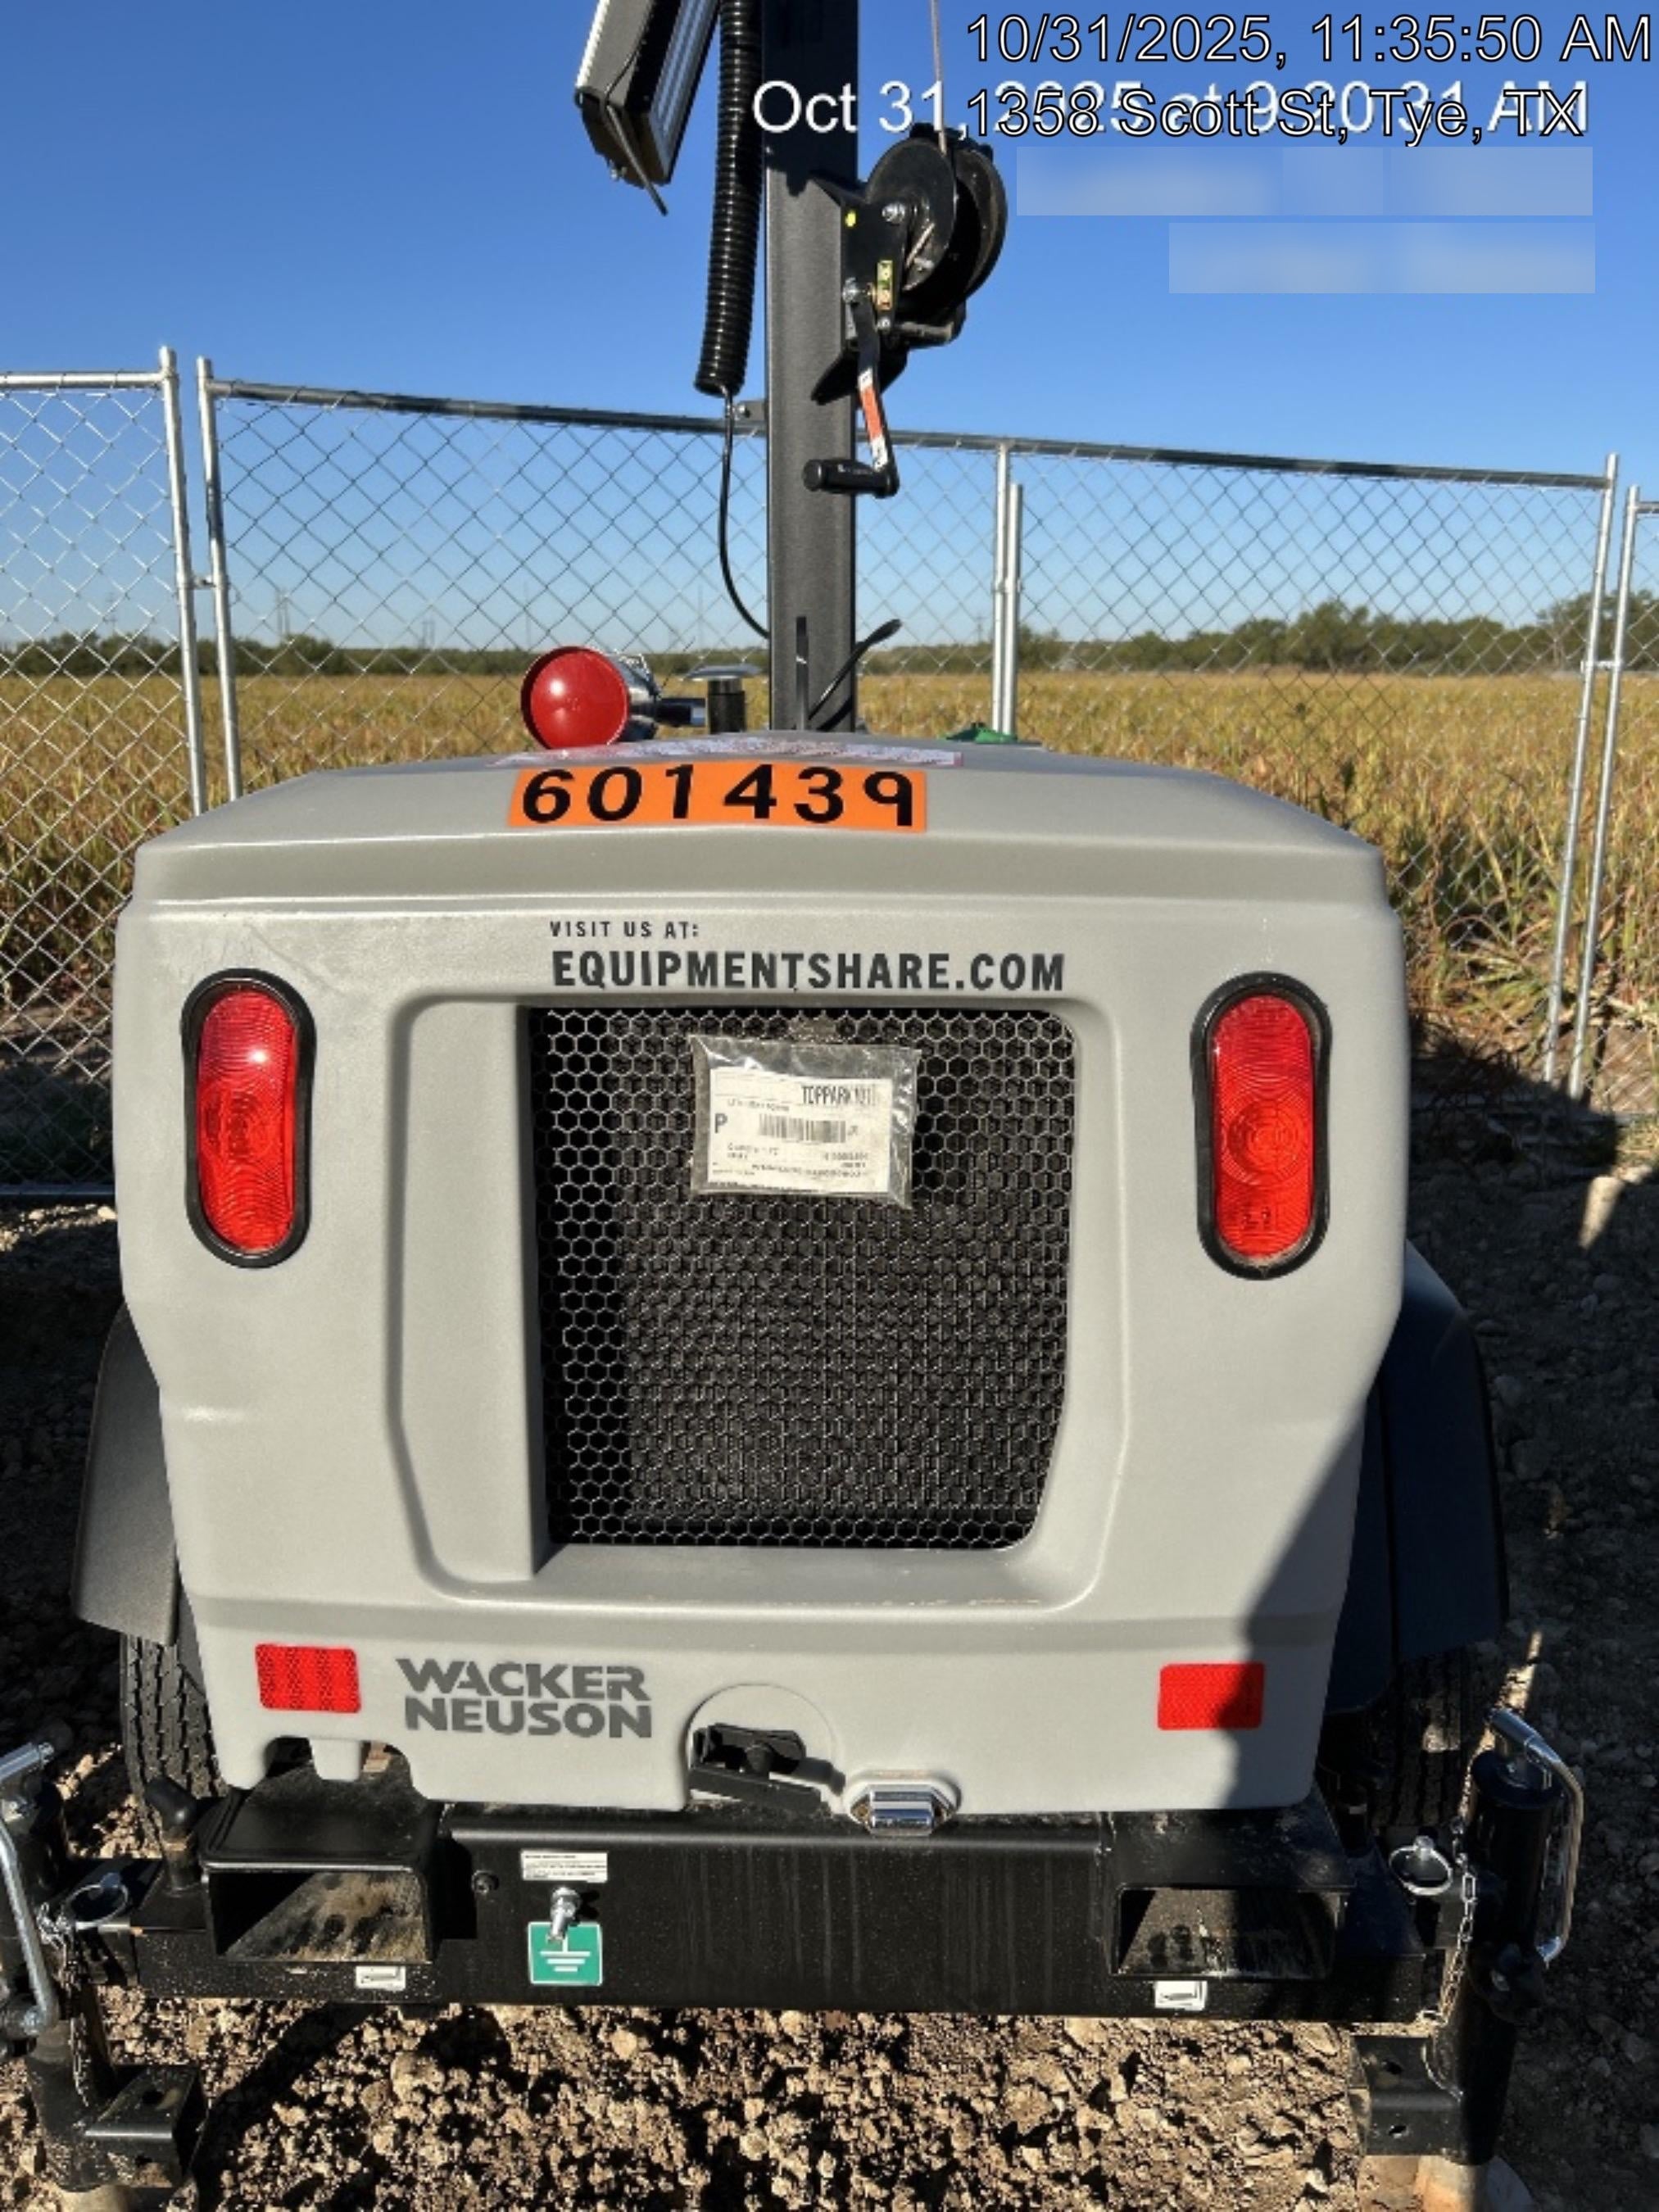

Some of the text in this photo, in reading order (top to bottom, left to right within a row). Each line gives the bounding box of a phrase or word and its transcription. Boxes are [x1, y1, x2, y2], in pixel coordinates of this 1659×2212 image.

[523, 764, 914, 827] 601439
[549, 921, 700, 940] VISIT US AT:
[551, 950, 1065, 991] EQUIPMENTSHARE.COM
[396, 1658, 652, 1702] WACKER
[404, 1696, 653, 1738] NEUSON
